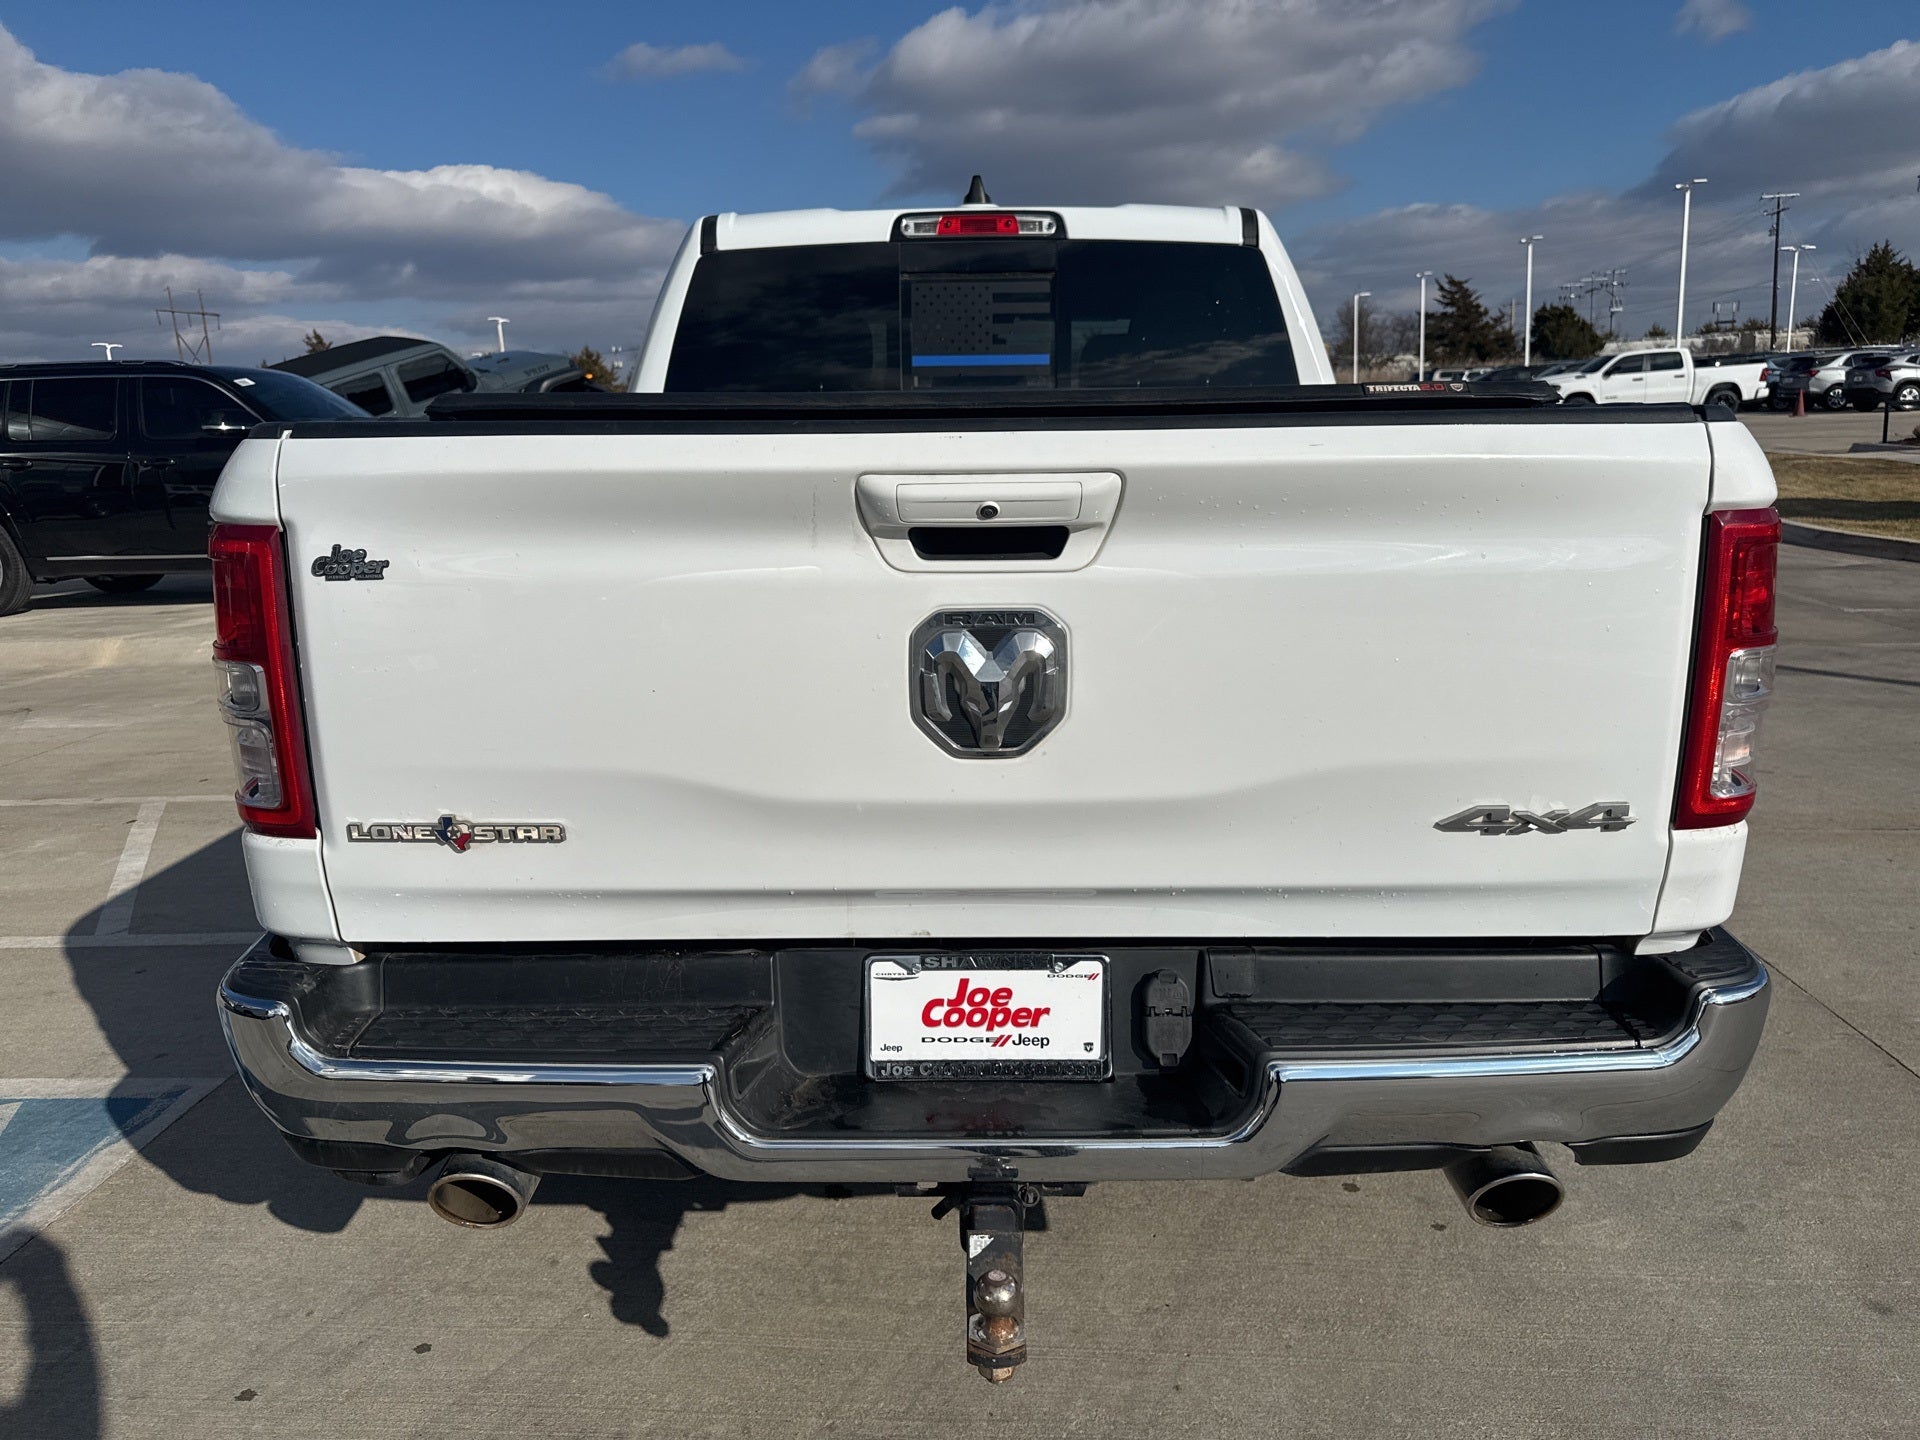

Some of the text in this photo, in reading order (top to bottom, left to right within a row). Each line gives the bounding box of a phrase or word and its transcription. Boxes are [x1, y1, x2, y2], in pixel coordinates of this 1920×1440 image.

[326, 544, 367, 563] Joe
[311, 556, 390, 577] Cooper
[943, 613, 1035, 626] RAM
[347, 823, 567, 843] LONE STAR
[947, 978, 1013, 1007] Joe
[921, 998, 1050, 1031] Cooper
[880, 1043, 903, 1053] Jeep
[1012, 1033, 1050, 1048] Jeep
[881, 1062, 914, 1076] Joe
